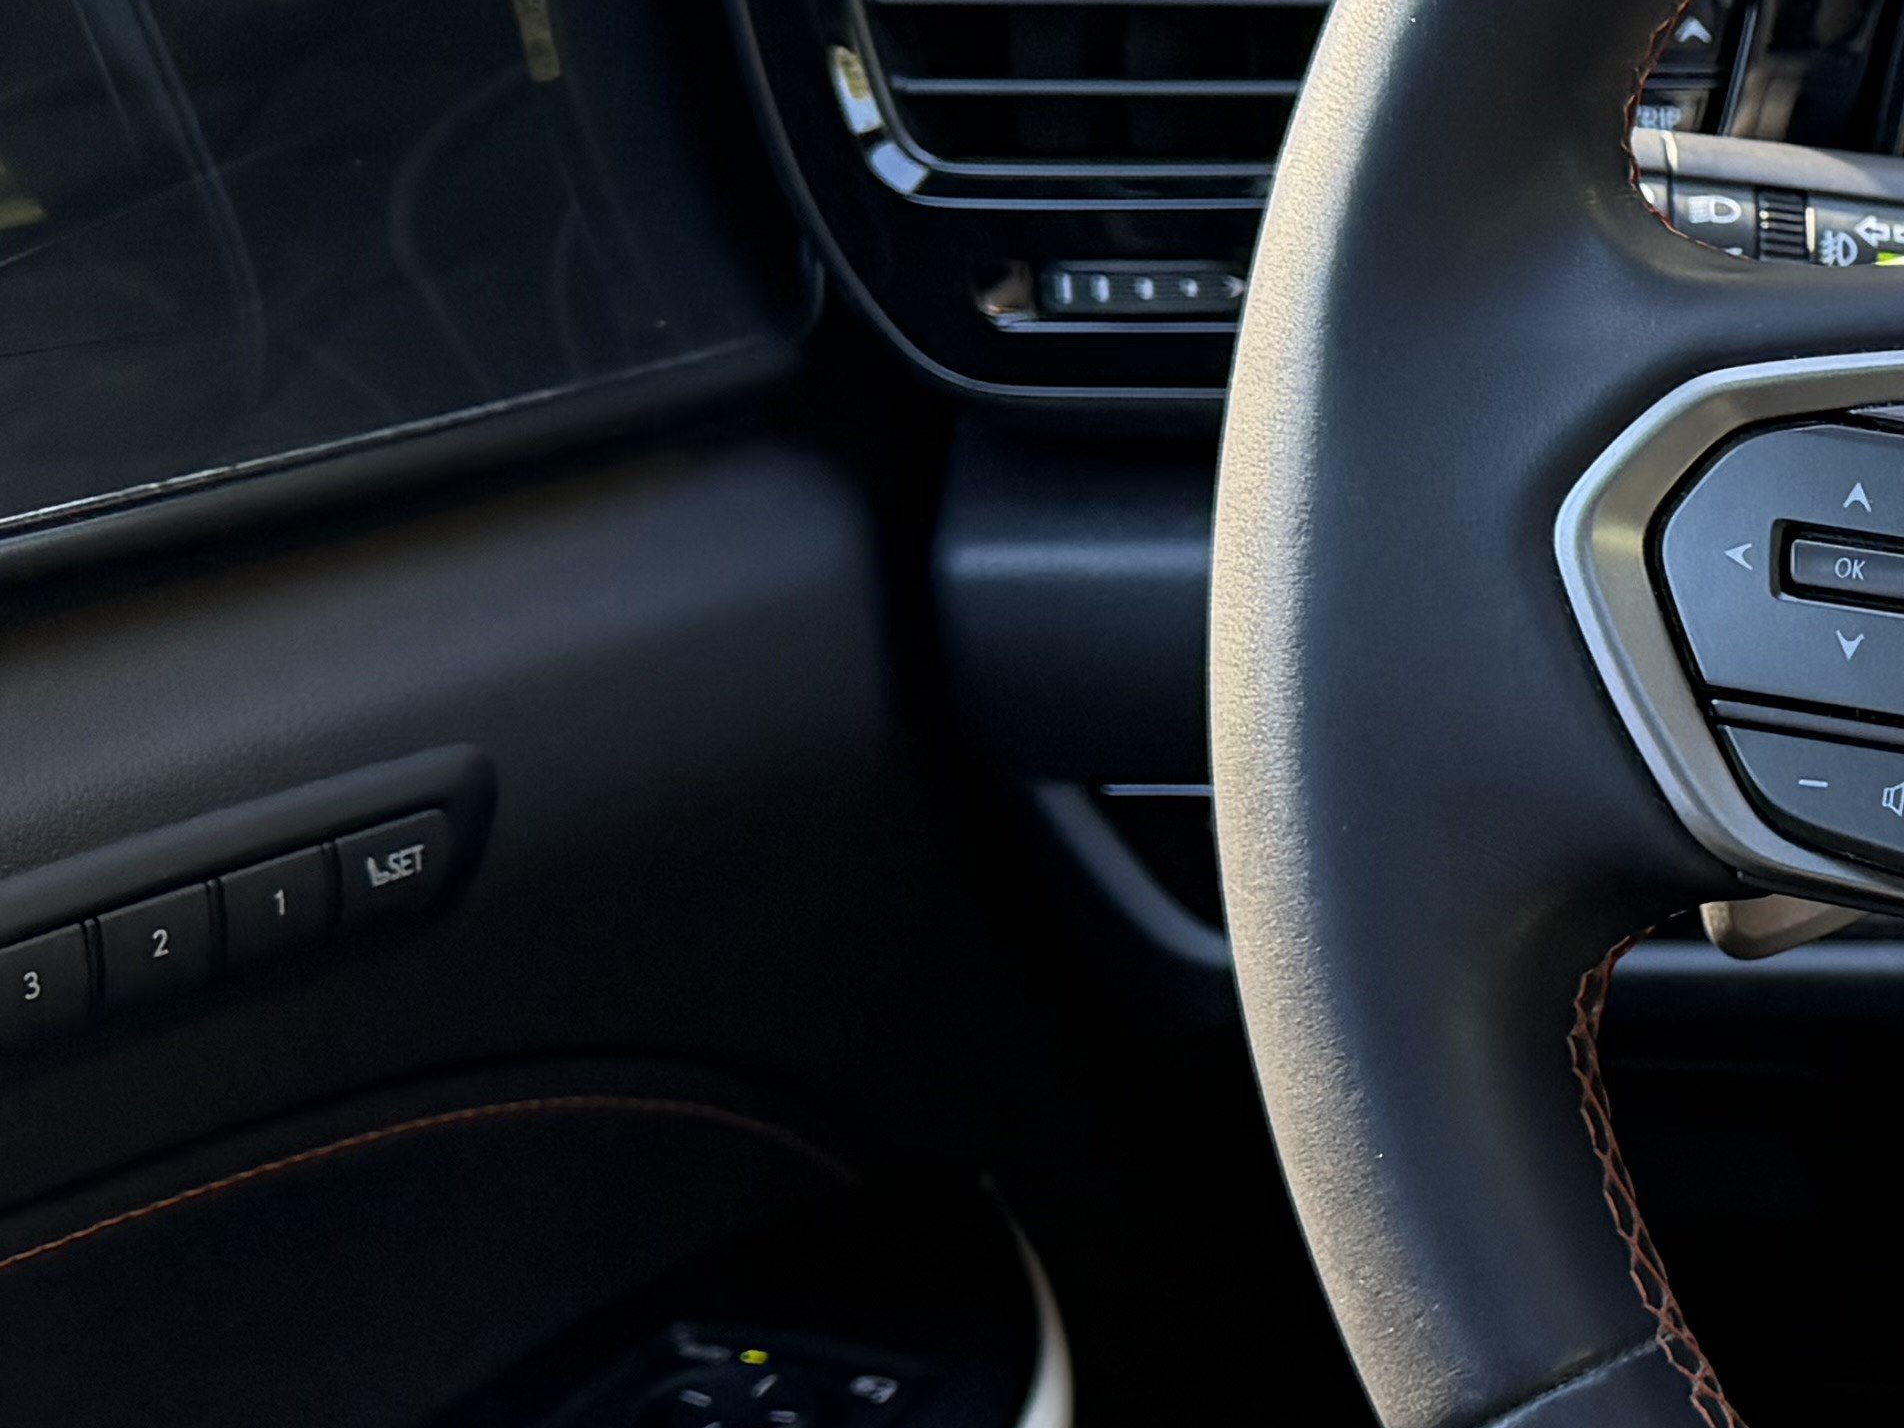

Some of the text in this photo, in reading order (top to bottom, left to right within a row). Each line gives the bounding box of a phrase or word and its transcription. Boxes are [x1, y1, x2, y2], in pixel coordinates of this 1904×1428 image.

[1834, 557, 1867, 582] OK
[387, 843, 425, 882] SET
[272, 889, 286, 916] 1
[151, 928, 170, 959] 2
[22, 971, 42, 1001] 3
